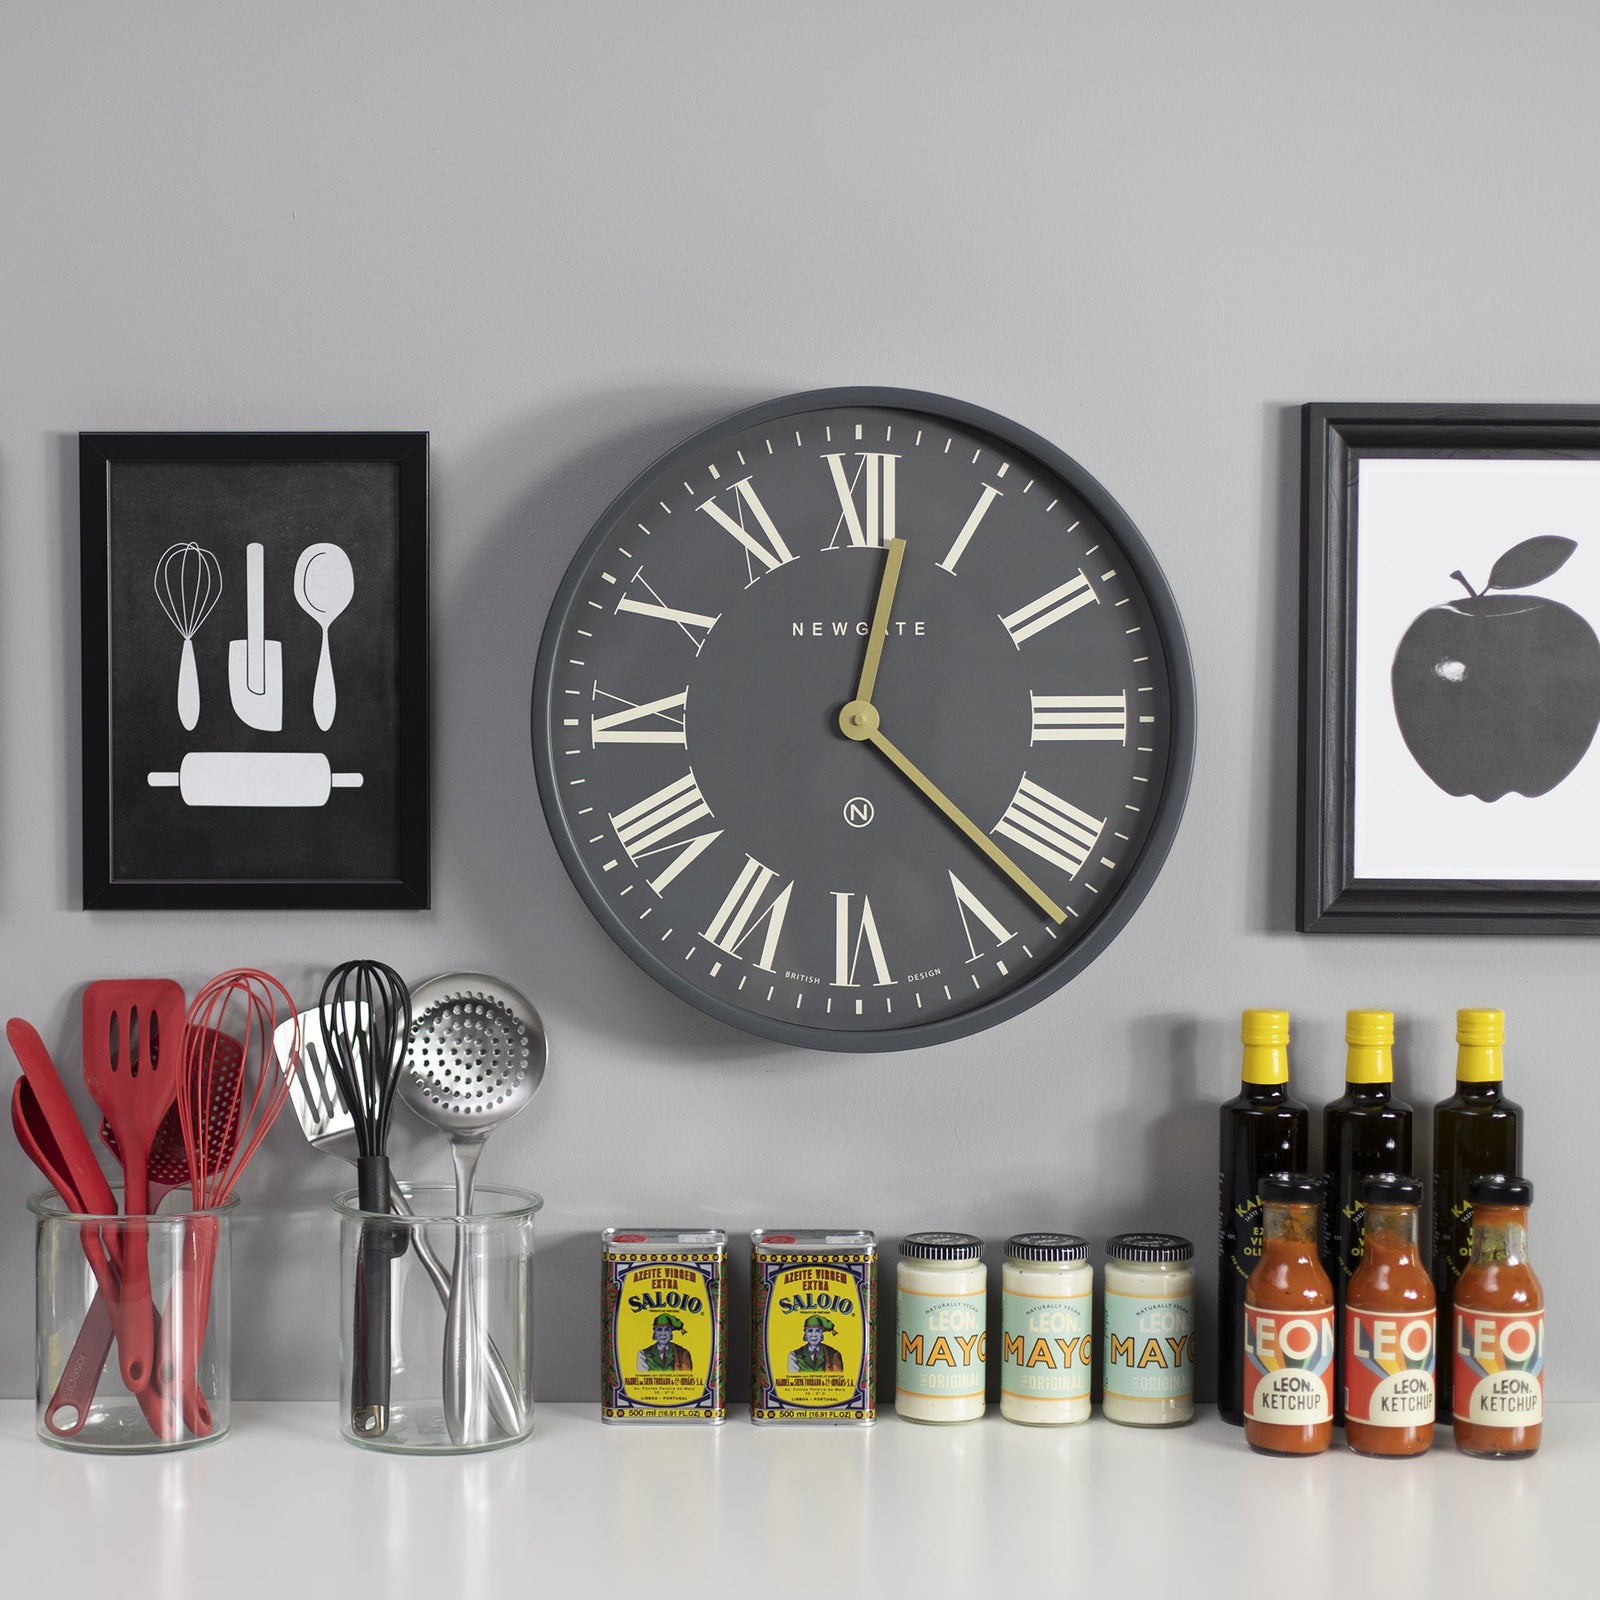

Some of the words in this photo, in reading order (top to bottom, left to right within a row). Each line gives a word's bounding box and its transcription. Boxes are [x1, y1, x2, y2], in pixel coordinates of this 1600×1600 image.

[820, 452, 902, 551] XII
[696, 475, 800, 589] XI
[935, 482, 1003, 576] I
[614, 566, 722, 657] X
[998, 568, 1100, 650] II
[792, 622, 926, 636] NEWGTE
[592, 680, 689, 749] IX
[1030, 689, 1127, 747] III
[608, 766, 725, 899] VIII
[699, 853, 795, 973] VII
[948, 869, 1017, 963] V
[829, 892, 899, 987] VI
[784, 970, 821, 985] BRITISH
[907, 967, 942, 983] DESIGN
[633, 1268, 661, 1283] AZEITE
[651, 1278, 678, 1289] EXTRA
[784, 1269, 812, 1284] AZEITE
[802, 1280, 829, 1291] EXTRA
[628, 1291, 702, 1314] SALOIO
[779, 1293, 854, 1315] SALOIO
[925, 1302, 961, 1314] NATURALLY
[1025, 1304, 1062, 1315] NATURALLY
[1135, 1303, 1172, 1316] NATURALLY
[928, 1372, 980, 1389] ORIGINAL
[1029, 1375, 1082, 1390] ORIGINAL
[1262, 1393, 1321, 1411] KETCHUP
[1381, 1394, 1433, 1412] KETCHUP
[1480, 1395, 1538, 1412] KETCHUP
[629, 1409, 643, 1417] 500
[779, 1410, 794, 1418] 500
